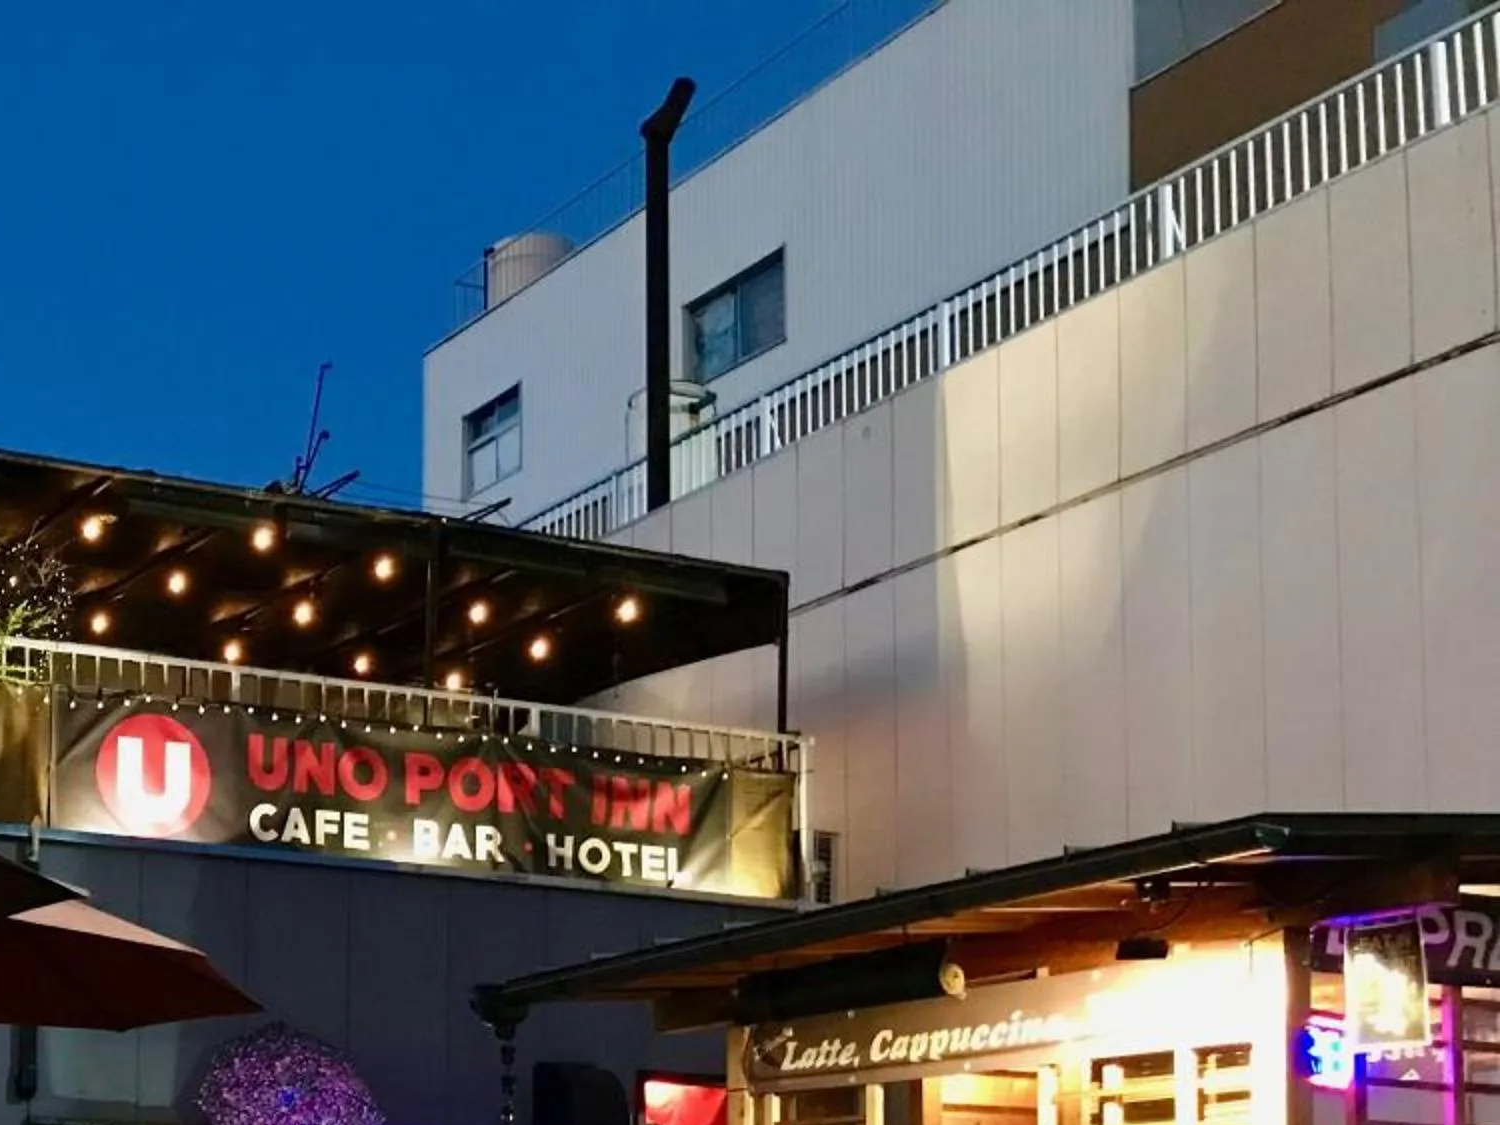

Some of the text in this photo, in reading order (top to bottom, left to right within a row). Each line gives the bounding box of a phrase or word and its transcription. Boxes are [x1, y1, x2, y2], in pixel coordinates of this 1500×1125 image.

[116, 735, 192, 830] U
[246, 733, 694, 836] UNO PORT INN
[249, 803, 686, 882] CAFE BAR HOTEL
[779, 1038, 862, 1072] Latte,
